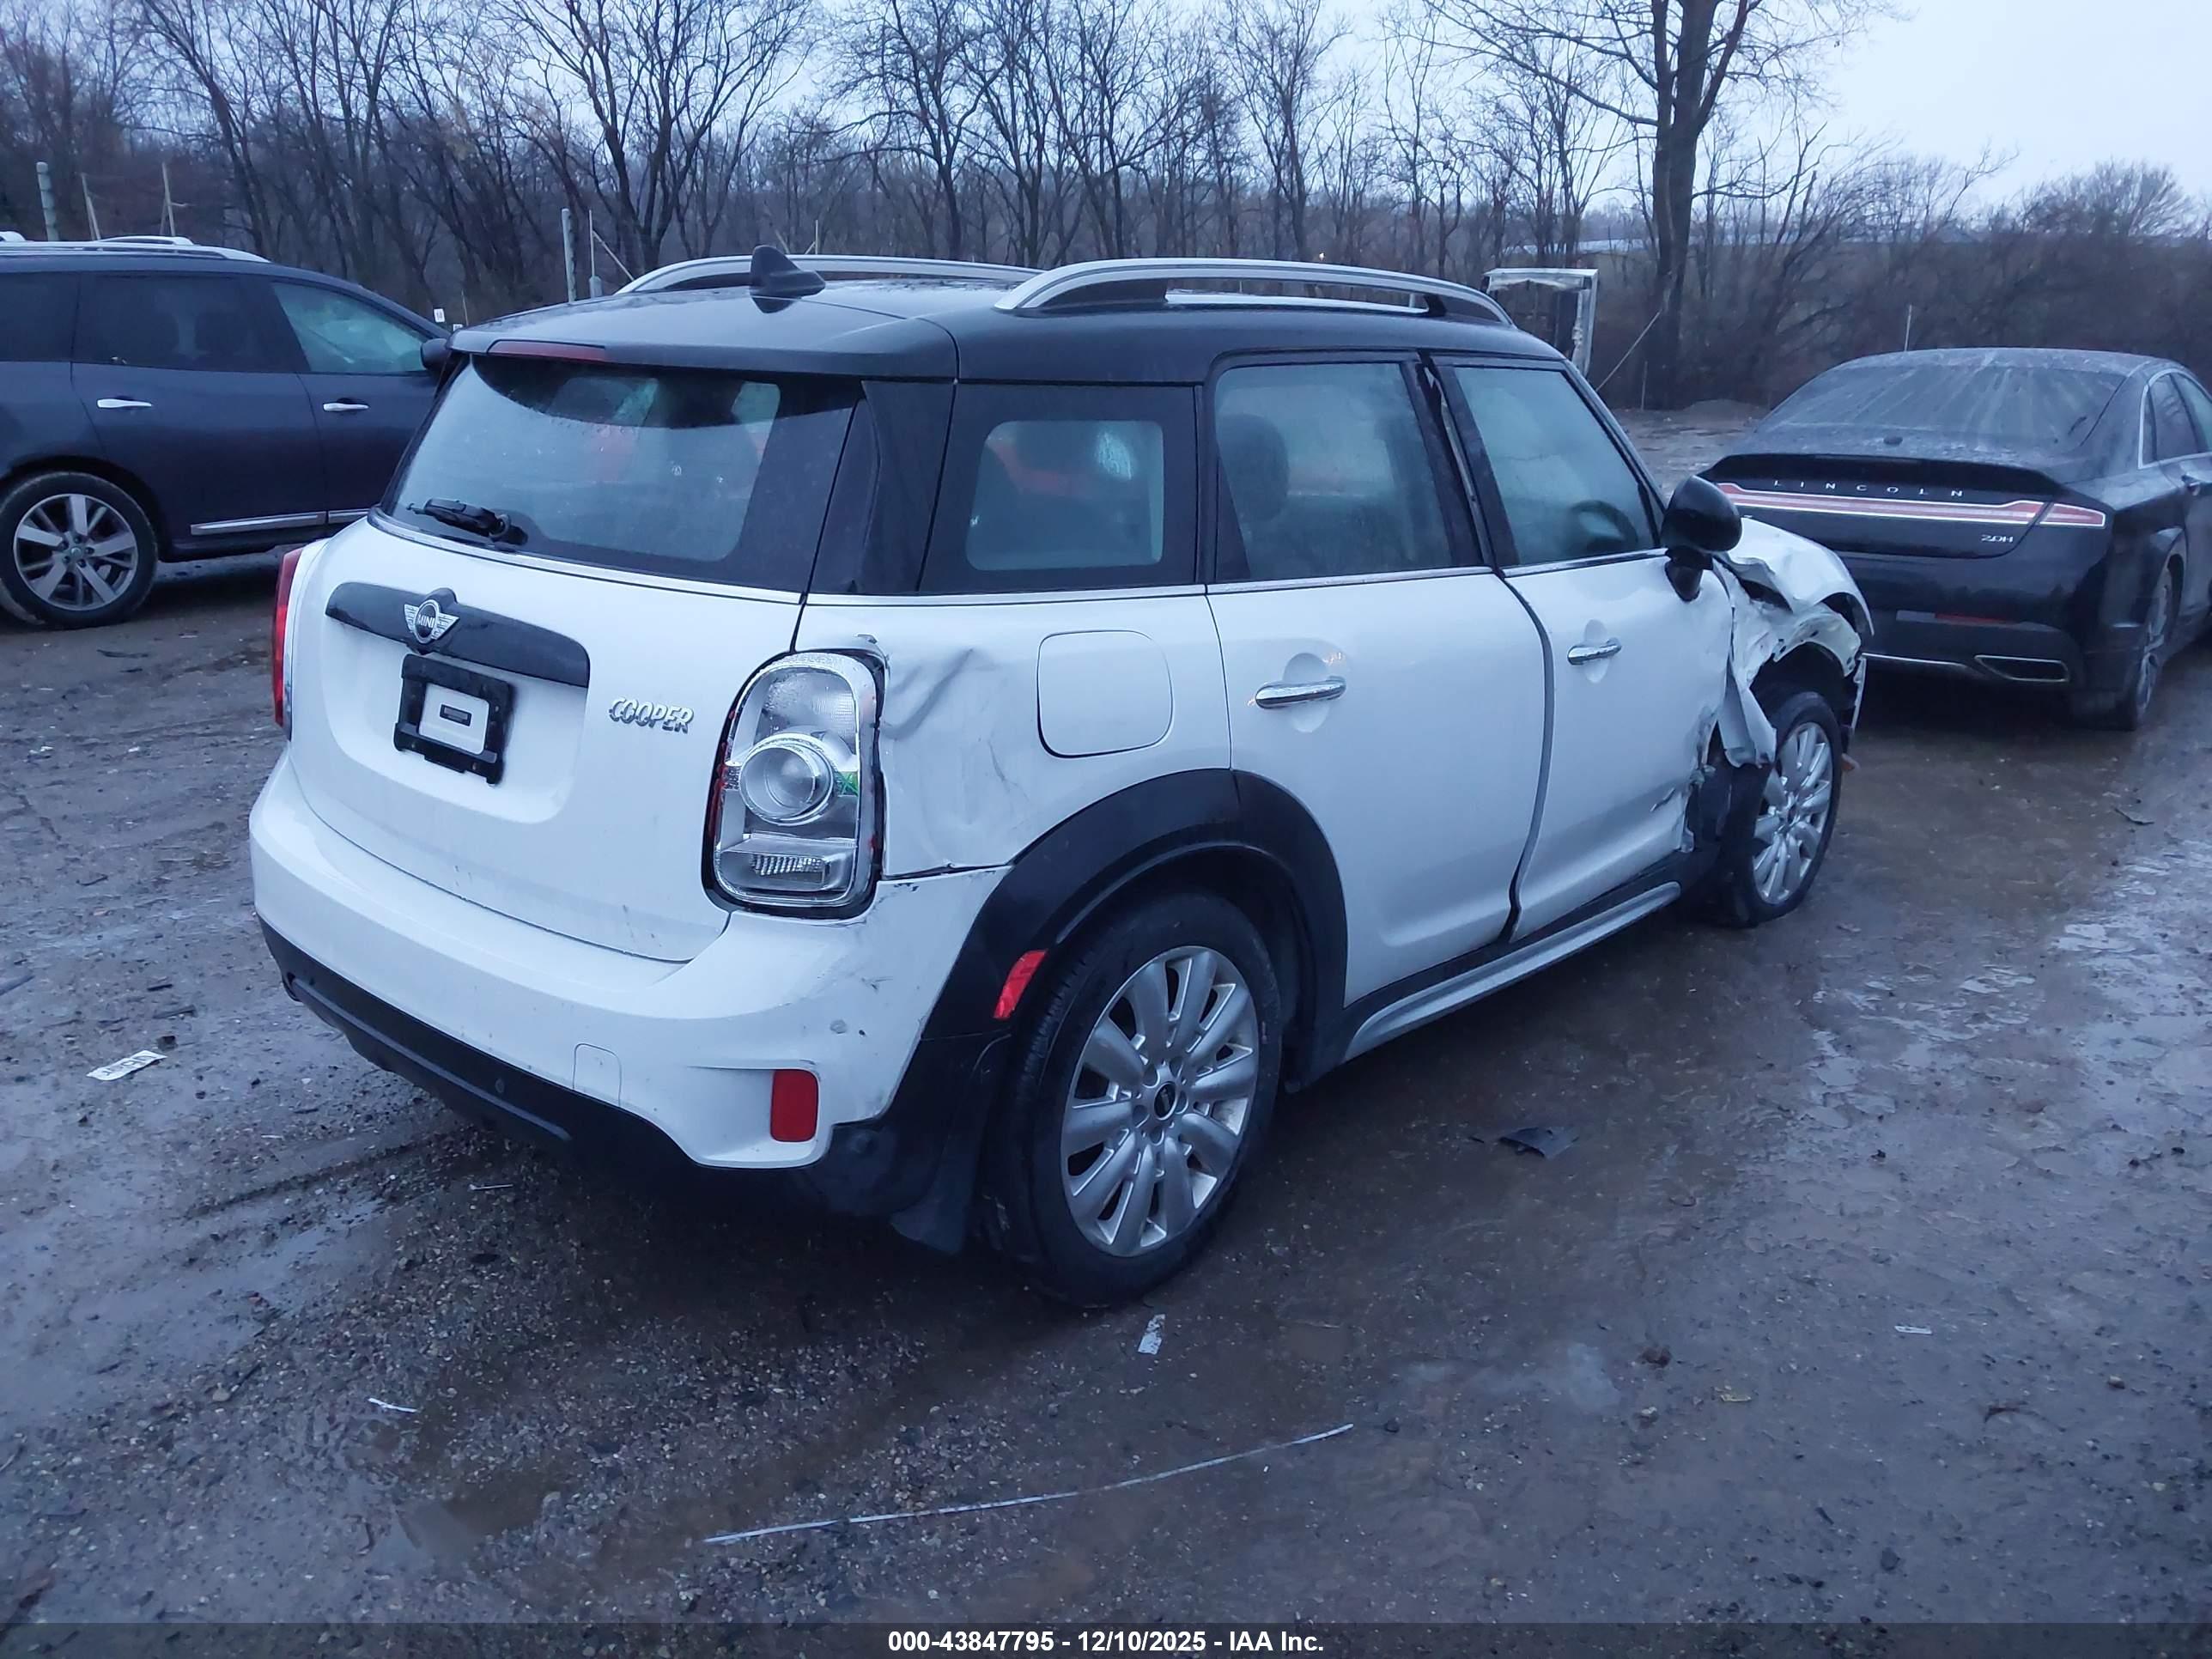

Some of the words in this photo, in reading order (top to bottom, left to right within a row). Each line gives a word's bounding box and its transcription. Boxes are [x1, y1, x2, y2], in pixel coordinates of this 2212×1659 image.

[1773, 479, 1964, 497] LINCOLN
[416, 613, 435, 629] MINI
[608, 696, 694, 734] COOPER
